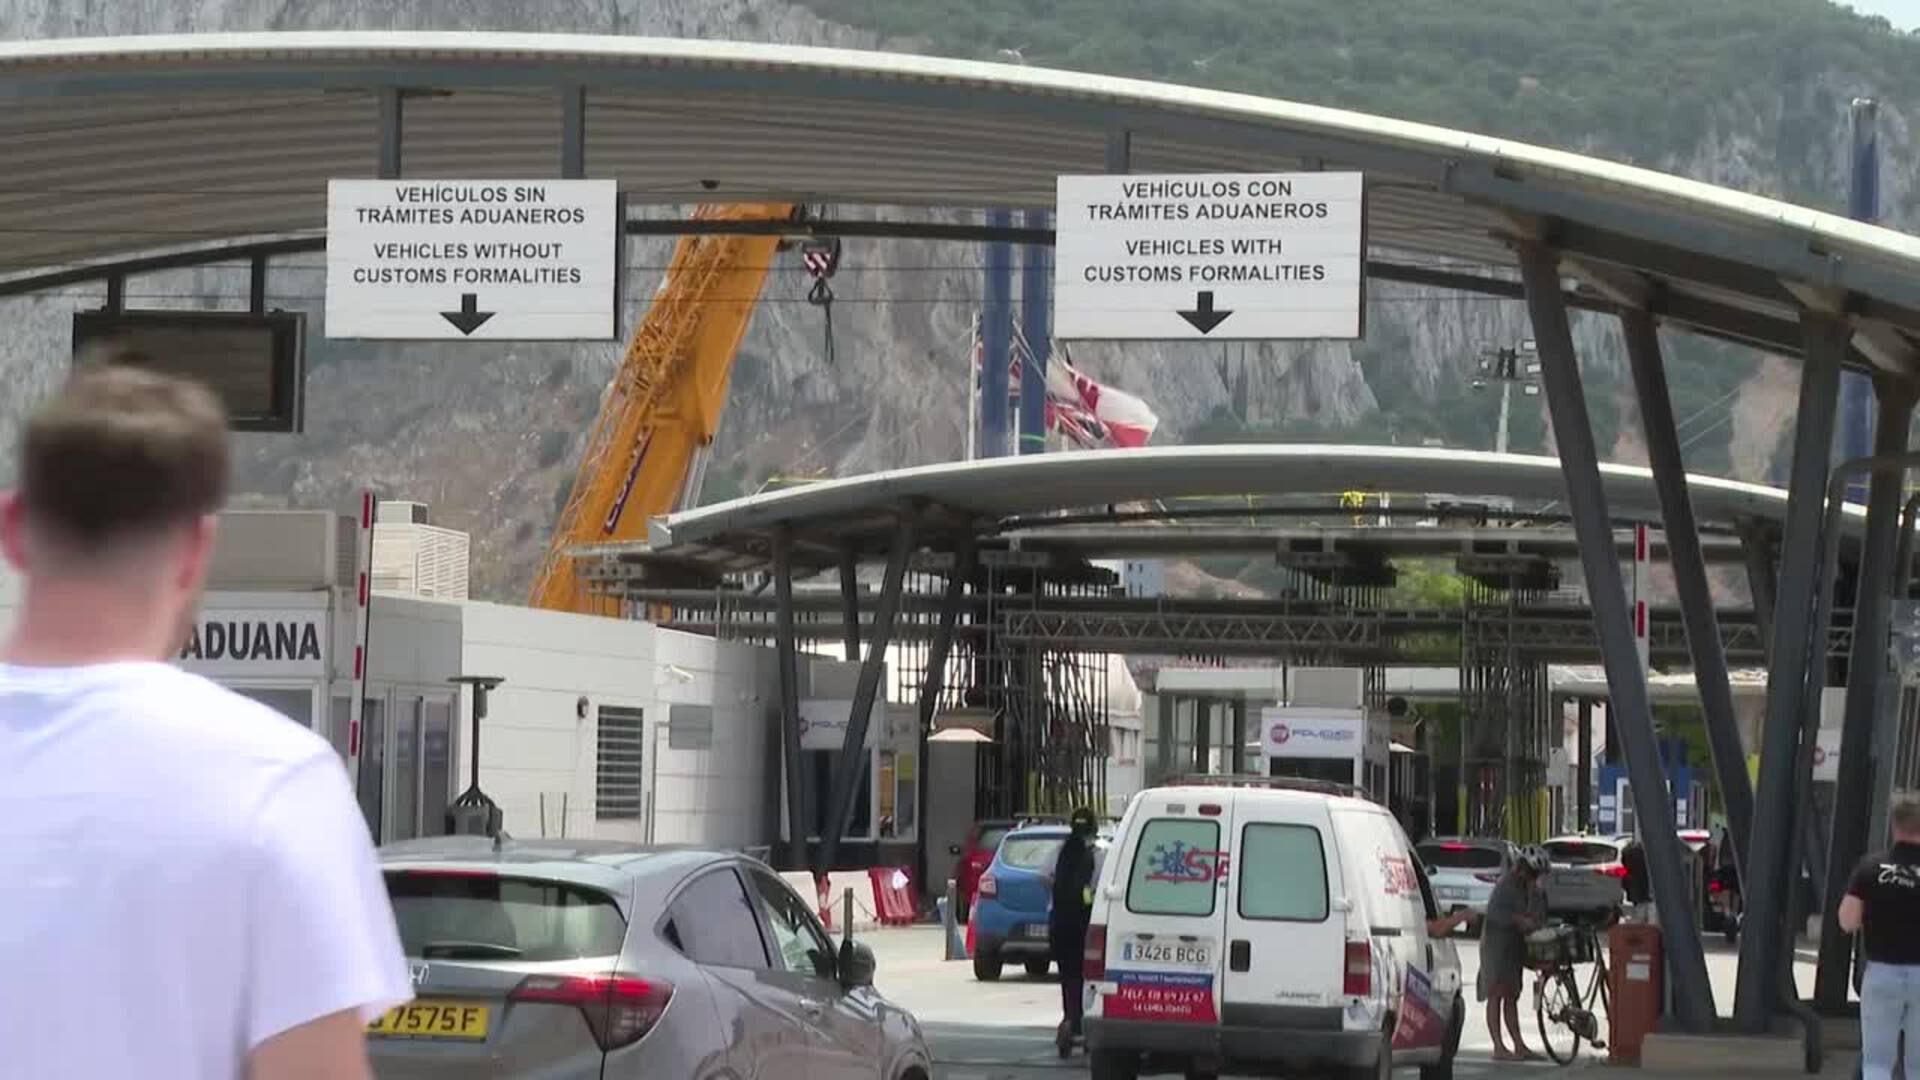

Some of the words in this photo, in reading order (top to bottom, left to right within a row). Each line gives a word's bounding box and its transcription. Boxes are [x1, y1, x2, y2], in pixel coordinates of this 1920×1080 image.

[396, 183, 507, 203] VEHÍCULOS
[514, 187, 545, 202] SIN
[1122, 179, 1240, 199] VEHÍCULOS
[1247, 180, 1292, 197] CON
[356, 205, 454, 224] TRÁMITES
[460, 208, 585, 224] ADUANEROS
[1087, 201, 1189, 220] TRÁMITES
[1195, 203, 1328, 219] ADUANEROS
[374, 243, 468, 259] VEHICLES
[474, 243, 562, 259] WITHOUT
[1125, 239, 1224, 256] VEHICLES
[1231, 239, 1282, 256] WITH
[353, 267, 447, 284] CUSTOMS
[453, 267, 581, 284] FORMALITIES
[1084, 265, 1182, 282] CUSTOMS
[1189, 264, 1325, 282] FORMALITIES
[180, 621, 321, 660] ADUANA
[1135, 944, 1171, 961] 3426
[1175, 946, 1206, 962] BCG
